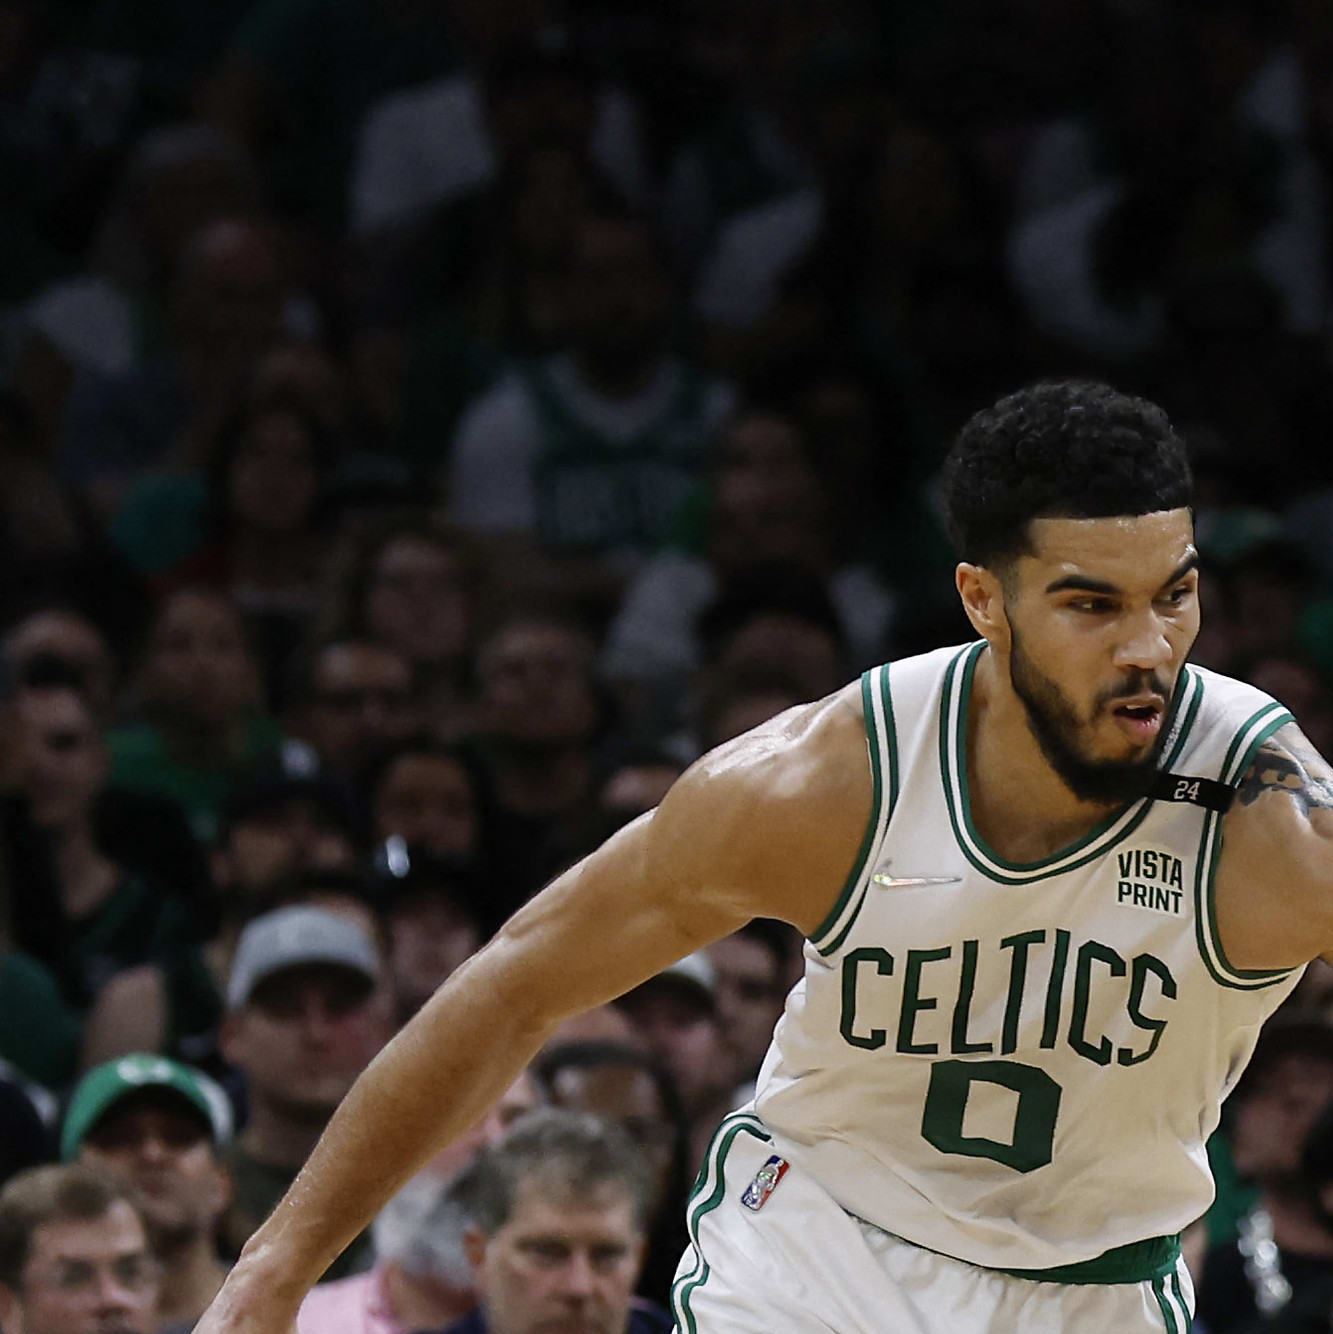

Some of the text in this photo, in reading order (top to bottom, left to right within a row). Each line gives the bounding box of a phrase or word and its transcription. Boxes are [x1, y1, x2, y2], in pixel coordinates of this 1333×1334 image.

[1173, 780, 1201, 801] 24
[1117, 849, 1184, 891] VISTA
[1117, 880, 1184, 914] PRINT
[839, 928, 1178, 1067] CELTICS
[920, 1059, 1063, 1174] 0
